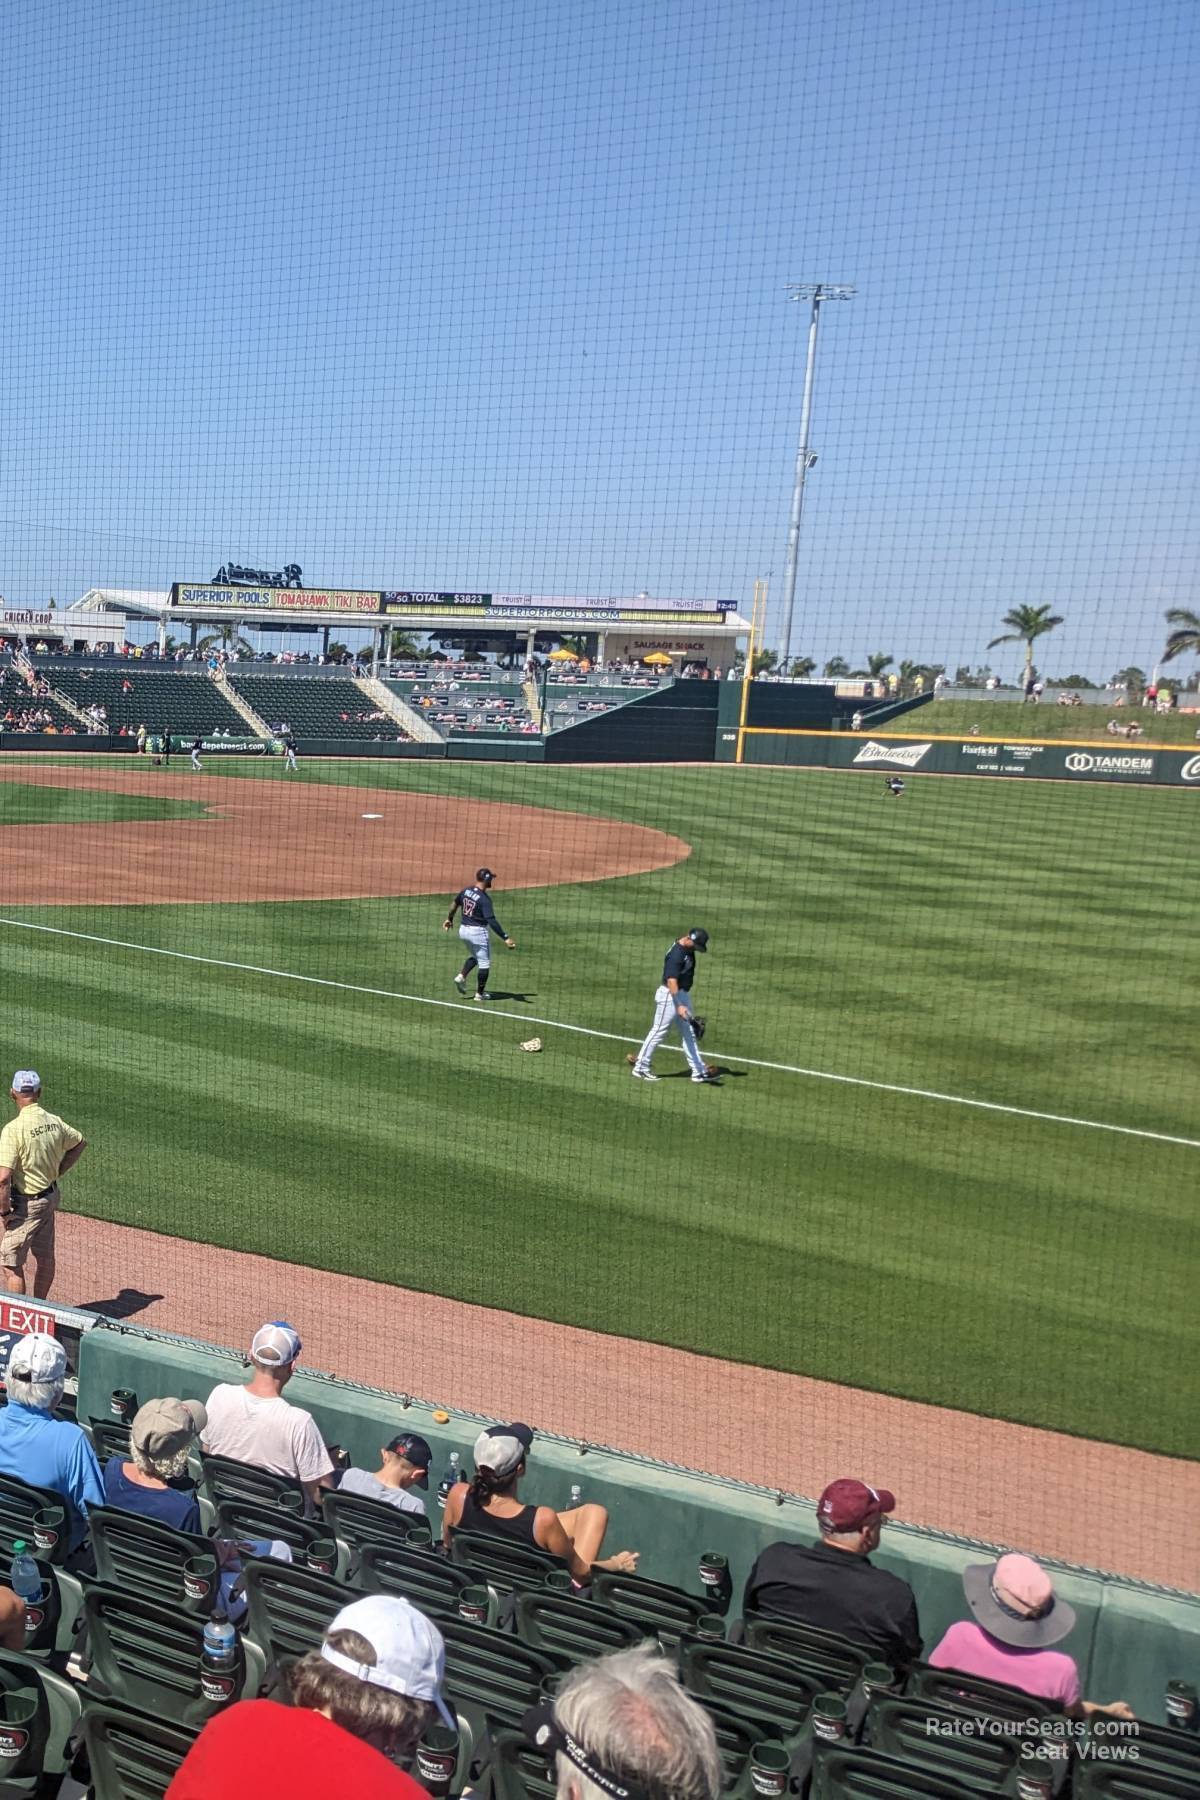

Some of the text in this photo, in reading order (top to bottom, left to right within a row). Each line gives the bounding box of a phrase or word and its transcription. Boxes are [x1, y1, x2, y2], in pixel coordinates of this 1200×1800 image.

[181, 589, 378, 609] SUPERIOR POOLS TOMAHAWK TIKI BAR
[411, 592, 444, 603] TOTAL:
[453, 594, 483, 604] $3823
[501, 596, 523, 604] TRUIST
[585, 598, 608, 607] TRUIST
[671, 600, 694, 609] TRUIST
[4, 611, 53, 624] CHICKEN COOP
[484, 606, 620, 619] SUPERIORPOOLS.COM
[634, 640, 705, 651] SAUSAGE SHACK
[860, 745, 923, 760] Budweiser
[1095, 756, 1153, 769] TANDEM
[9, 1307, 50, 1335] EXIT
